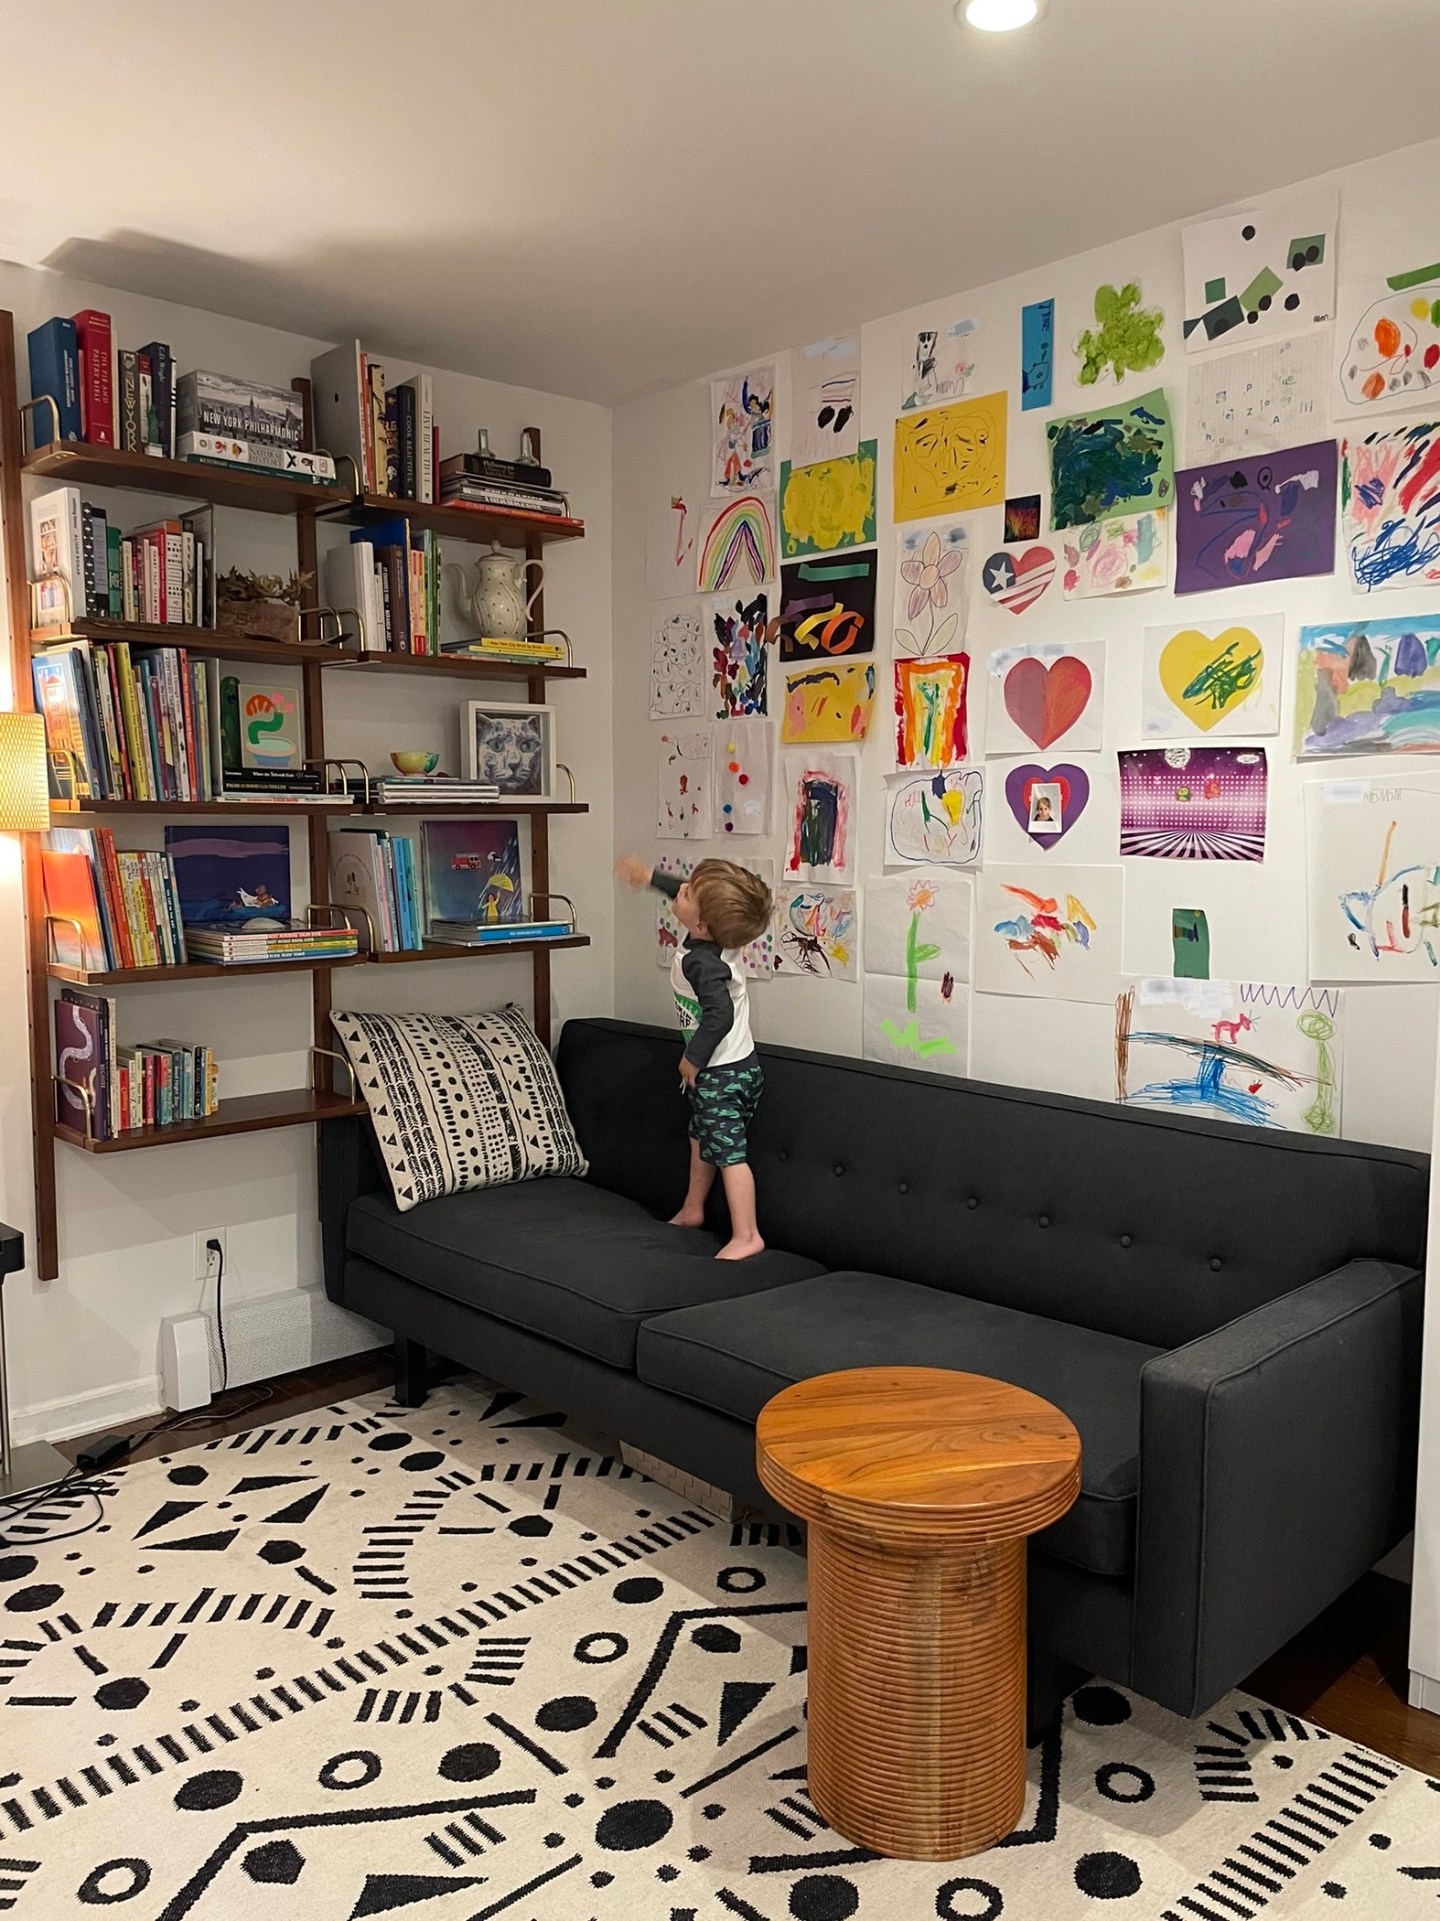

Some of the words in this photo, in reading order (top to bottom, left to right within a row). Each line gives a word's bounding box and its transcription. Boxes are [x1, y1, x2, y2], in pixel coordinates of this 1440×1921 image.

[203, 410, 221, 425] NEW
[223, 415, 243, 430] YORK
[244, 419, 300, 442] PHILHARMONIC
[423, 410, 431, 431] LIVE
[423, 433, 431, 483] BEAUTIFUL
